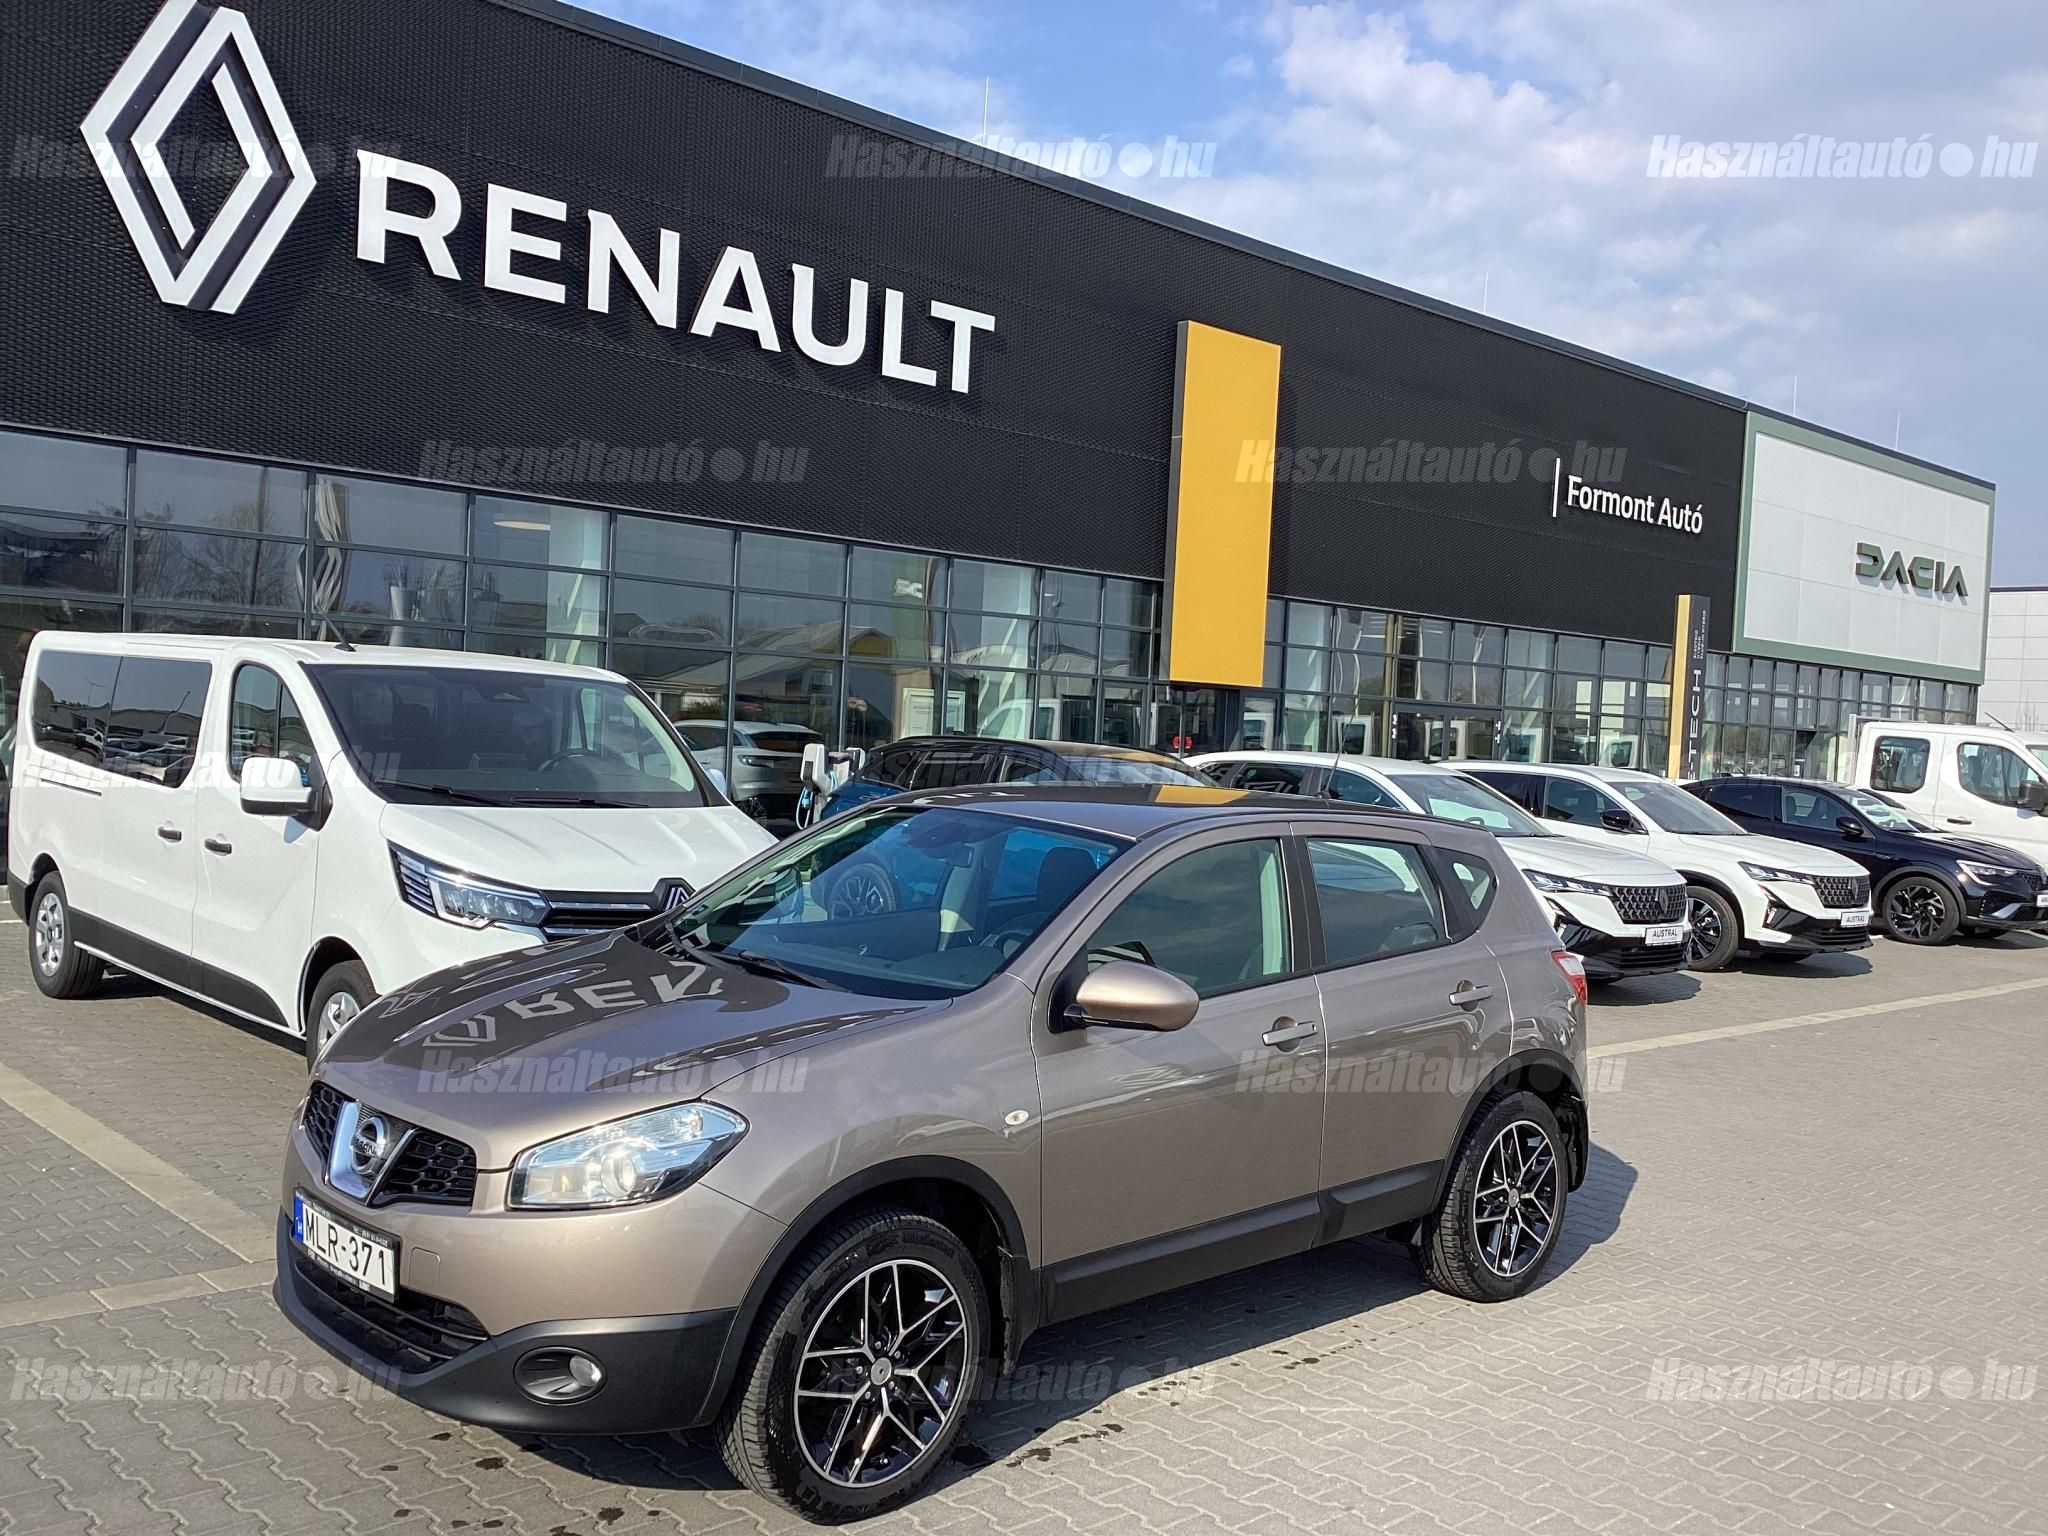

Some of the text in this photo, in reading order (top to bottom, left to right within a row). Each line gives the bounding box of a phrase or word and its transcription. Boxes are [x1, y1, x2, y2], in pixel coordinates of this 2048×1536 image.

[356, 149, 996, 394] RENAULT
[1567, 475, 1703, 534] Formont Autó
[1855, 542, 1968, 597] DACIA
[1653, 928, 1678, 938] AUSTRAL
[304, 1206, 386, 1286] MLR-371
